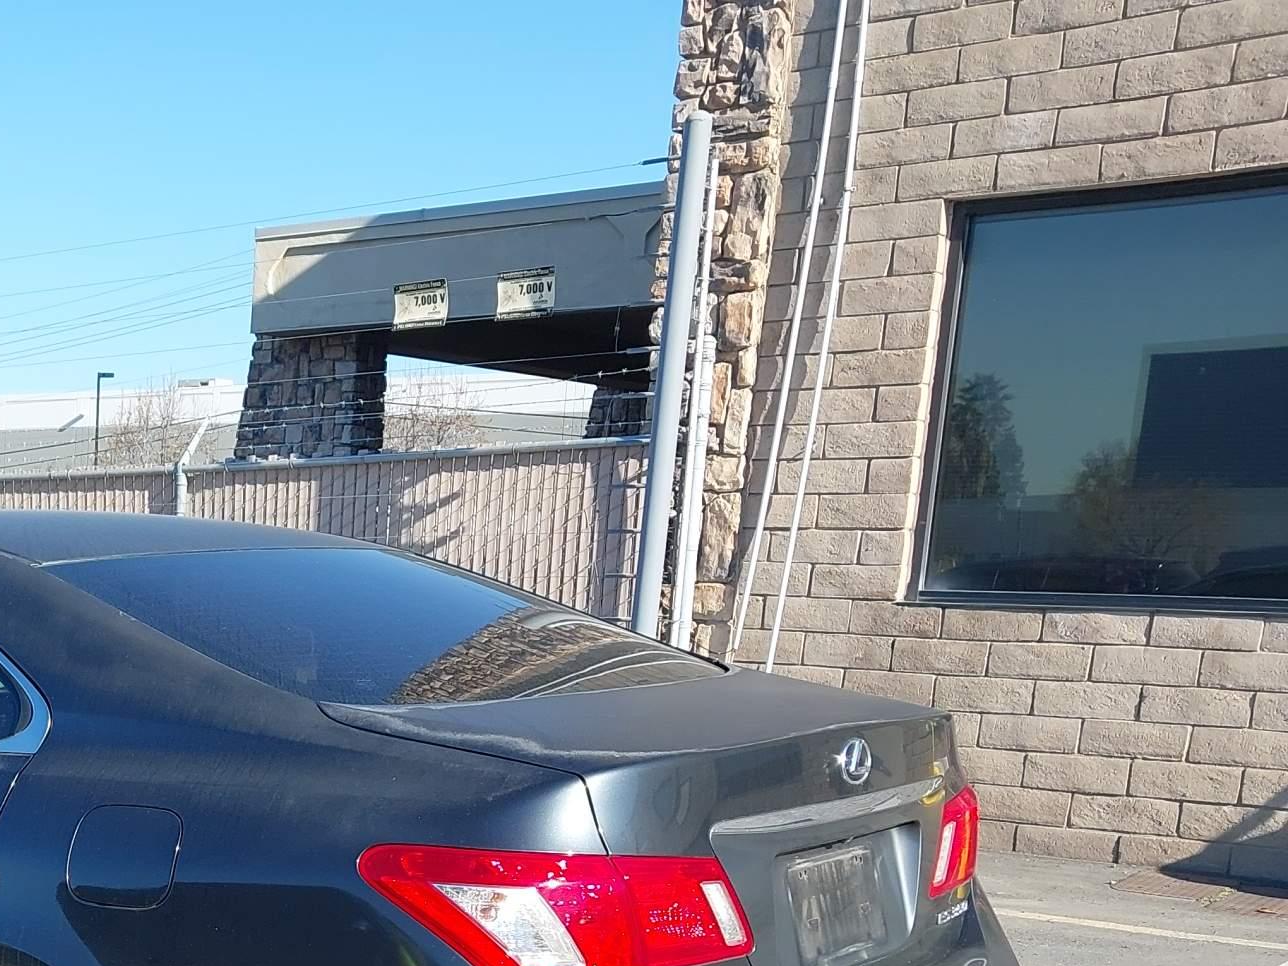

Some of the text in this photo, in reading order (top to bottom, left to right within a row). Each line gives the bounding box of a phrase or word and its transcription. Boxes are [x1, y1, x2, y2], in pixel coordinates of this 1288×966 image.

[518, 281, 553, 297] 7,000 V
[413, 293, 438, 308] 7,000
[439, 292, 446, 304] V
